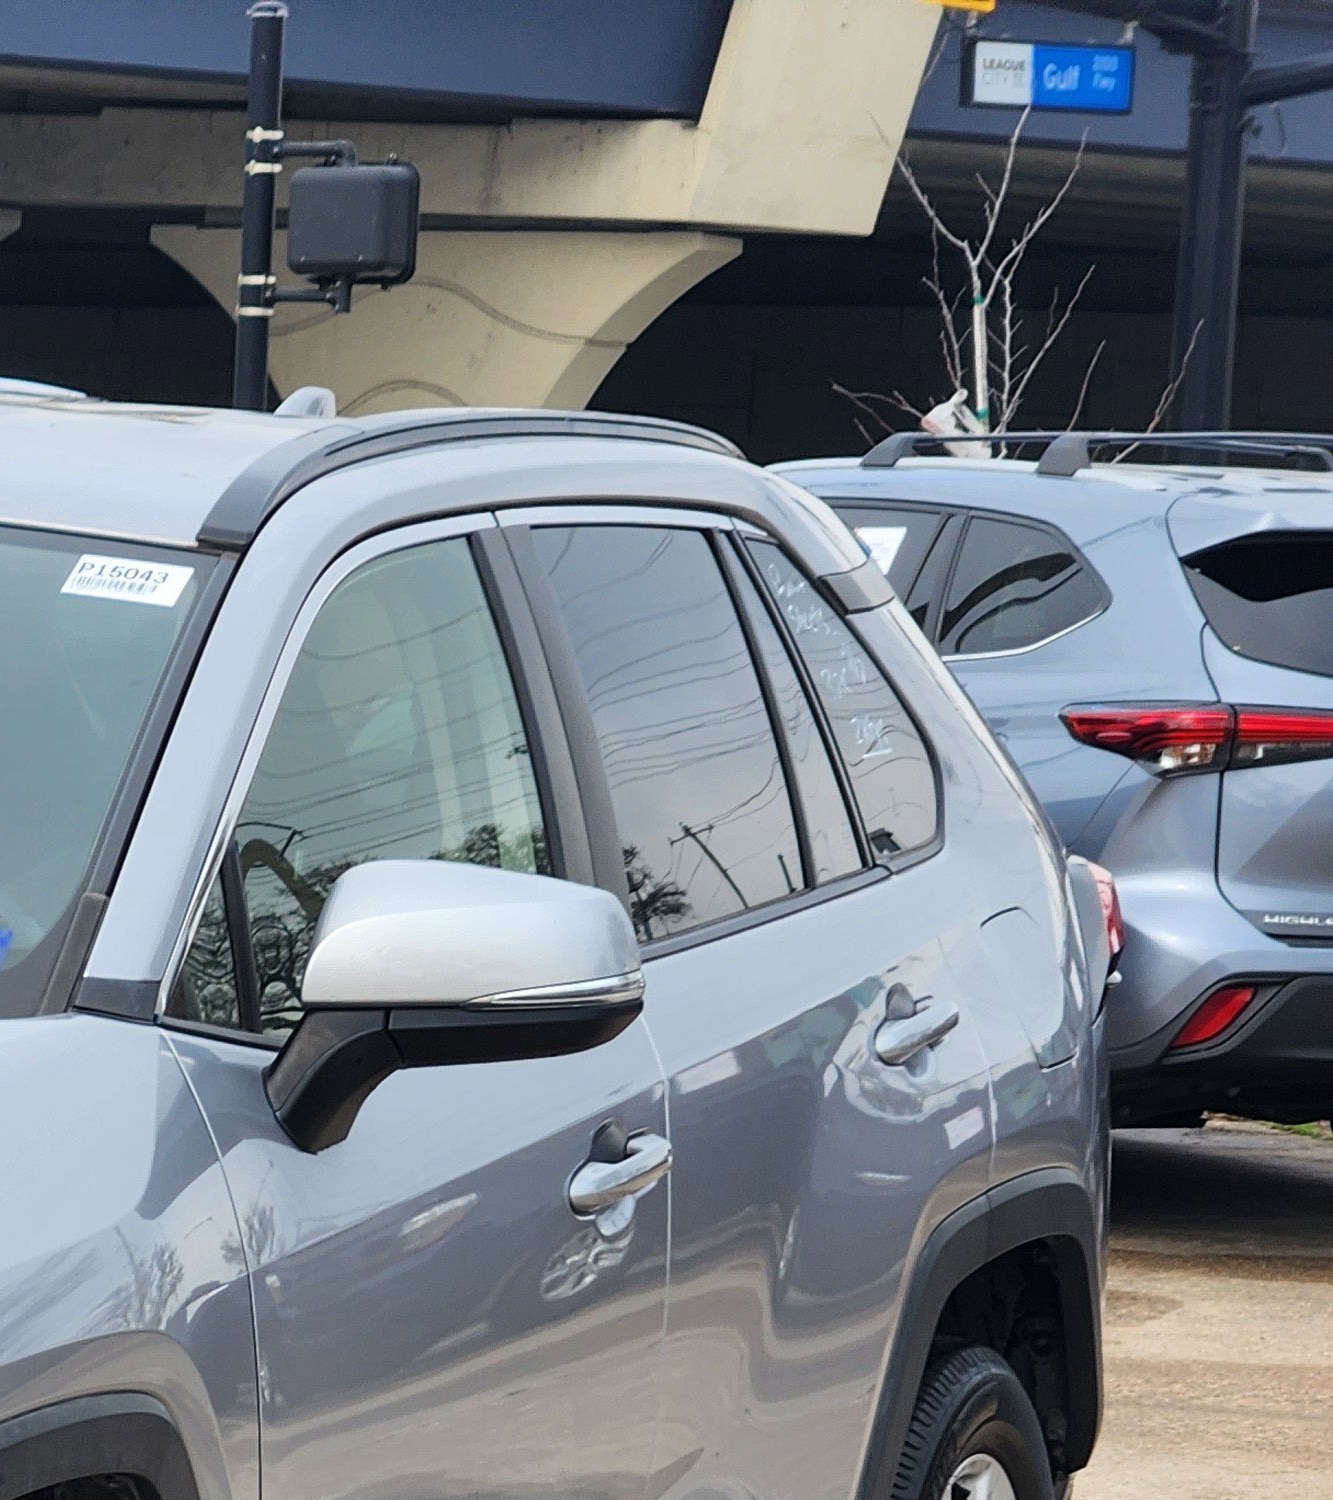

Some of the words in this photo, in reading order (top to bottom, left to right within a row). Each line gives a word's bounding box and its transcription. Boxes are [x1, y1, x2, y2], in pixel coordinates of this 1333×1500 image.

[983, 58, 1026, 72] LEAGUE
[1043, 62, 1081, 91] Gulf
[78, 561, 170, 584] P15043
